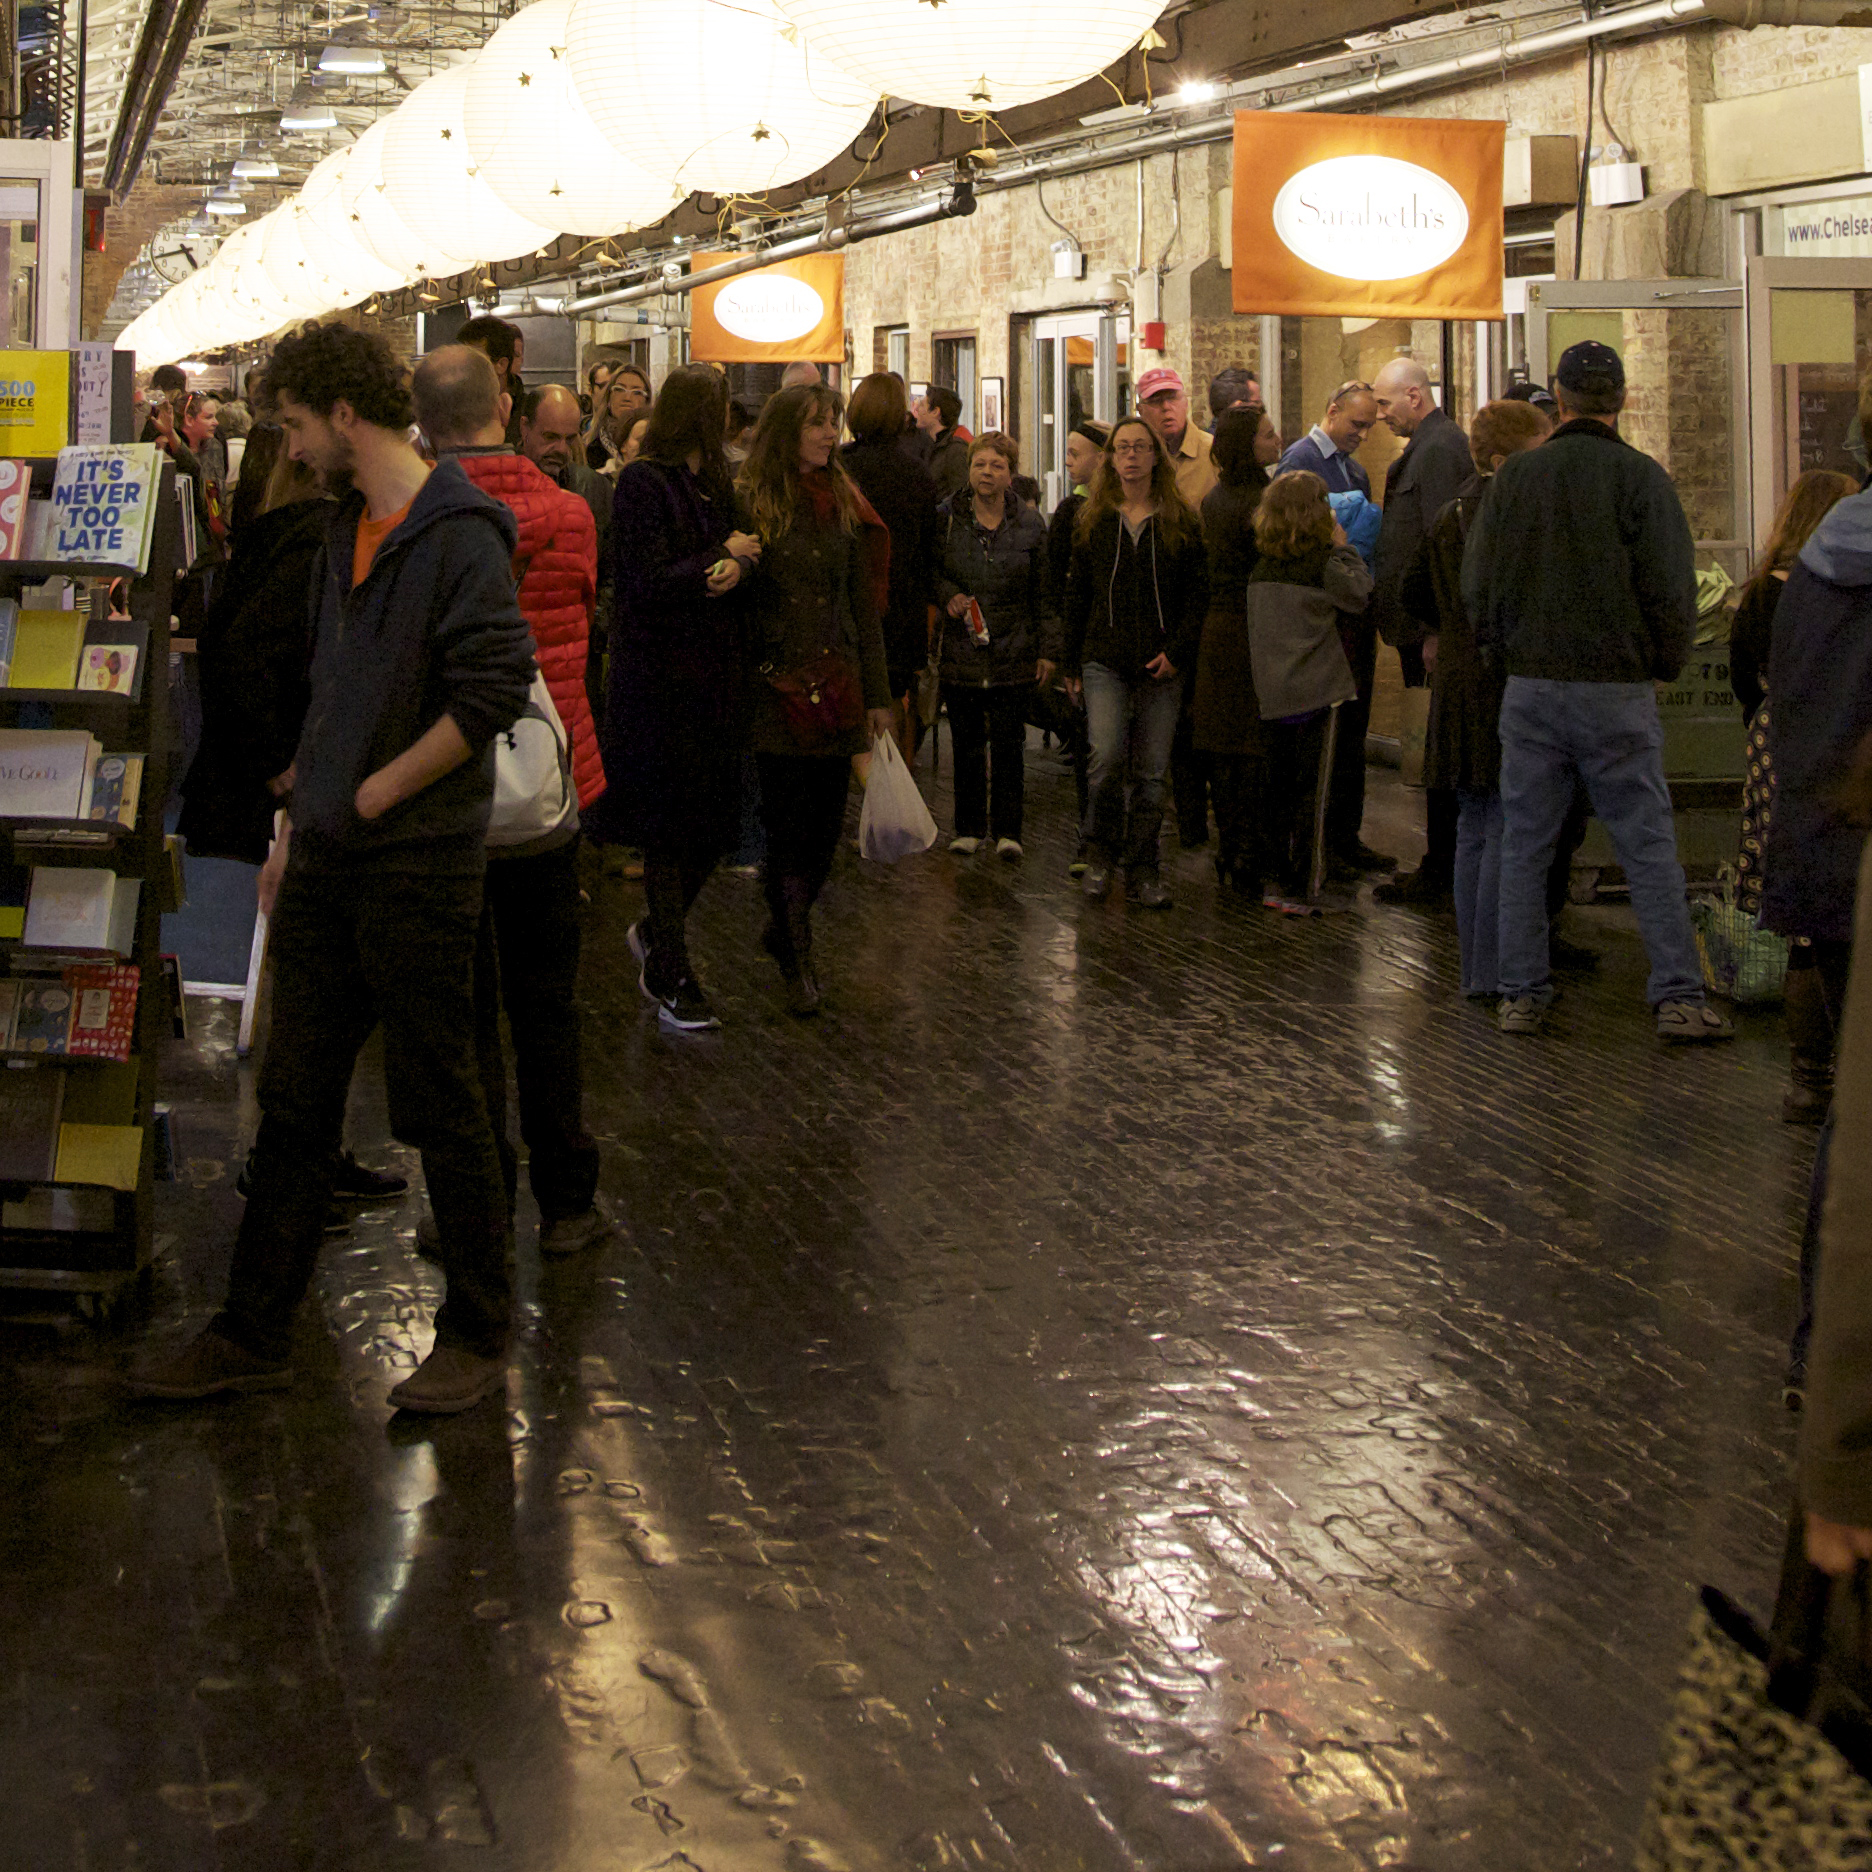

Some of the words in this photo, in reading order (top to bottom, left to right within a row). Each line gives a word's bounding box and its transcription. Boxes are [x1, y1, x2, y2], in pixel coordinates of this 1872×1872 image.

[1297, 190, 1446, 230] Sarabeth's
[77, 459, 125, 483] IT'S
[54, 482, 141, 506] NEVER
[67, 505, 121, 529] TOO
[57, 528, 124, 551] LATE
